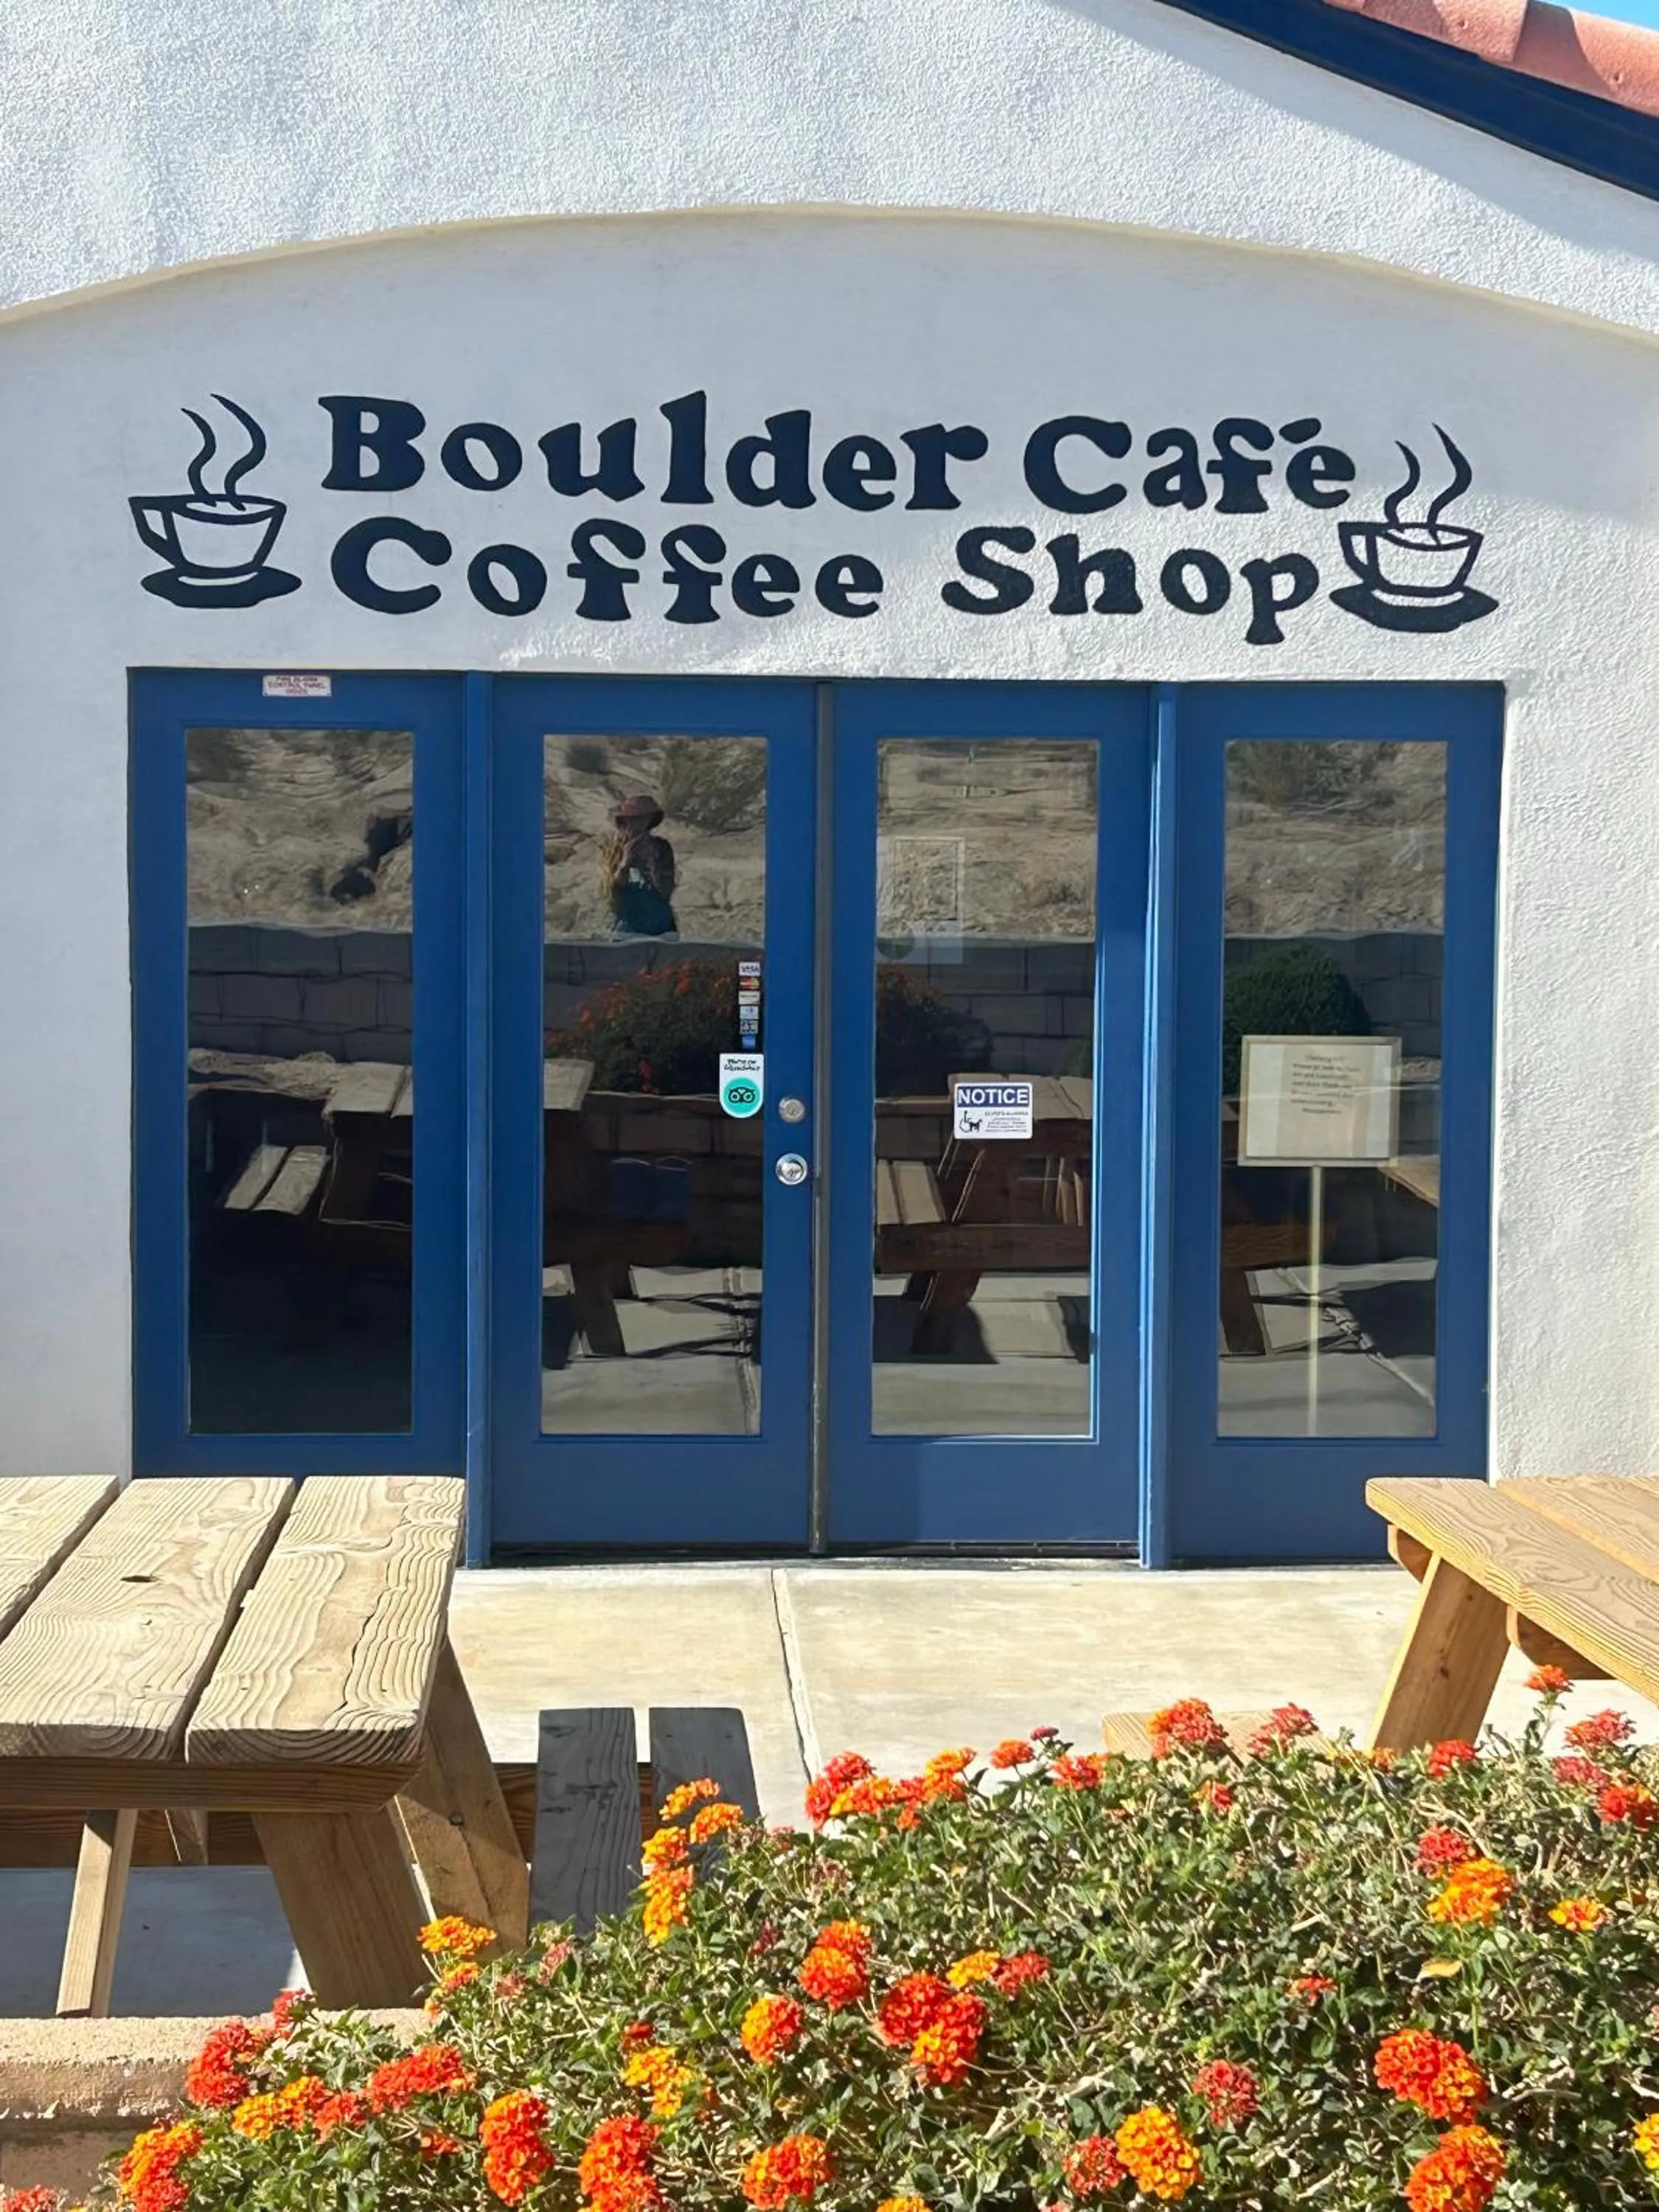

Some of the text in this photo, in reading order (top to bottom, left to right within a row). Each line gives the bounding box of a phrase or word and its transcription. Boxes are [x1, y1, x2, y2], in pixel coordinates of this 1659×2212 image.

[318, 389, 1356, 515] Boulder Café
[330, 516, 1320, 645] Coffee Shop
[958, 1088, 1029, 1105] NOTICE
